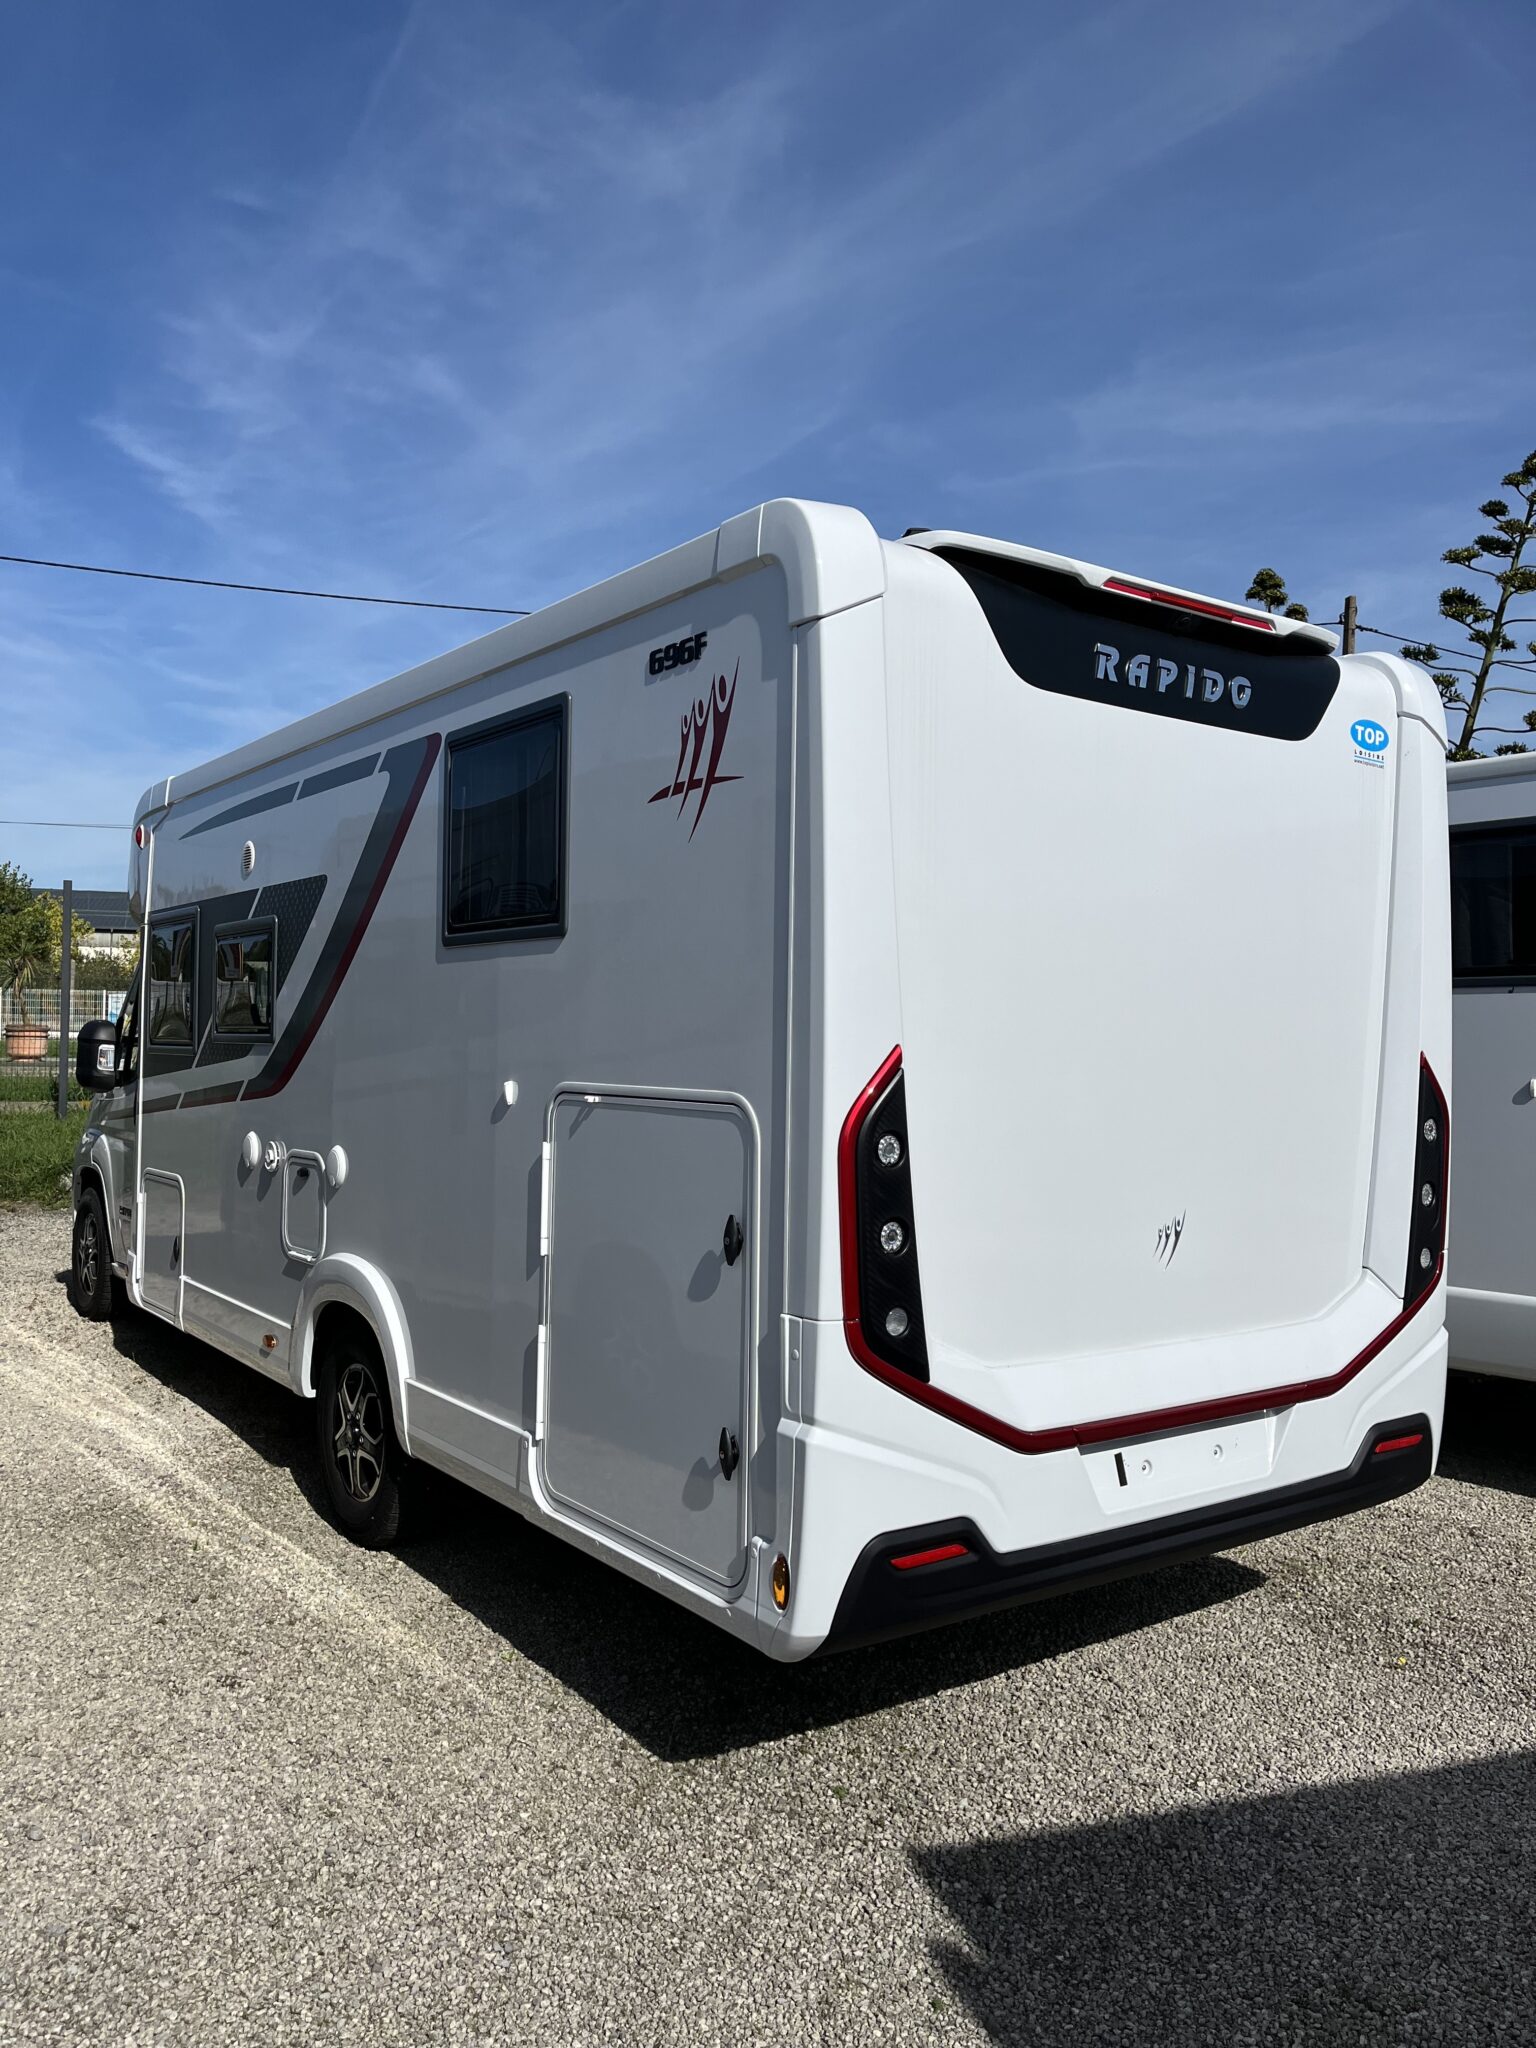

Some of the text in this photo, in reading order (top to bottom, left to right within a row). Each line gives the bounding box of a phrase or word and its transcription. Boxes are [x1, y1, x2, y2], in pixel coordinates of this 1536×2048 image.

[649, 631, 708, 675] 696F
[1094, 642, 1252, 709] RAPIDO
[1355, 725, 1385, 745] TOP
[1354, 749, 1385, 761] LOISIRS
